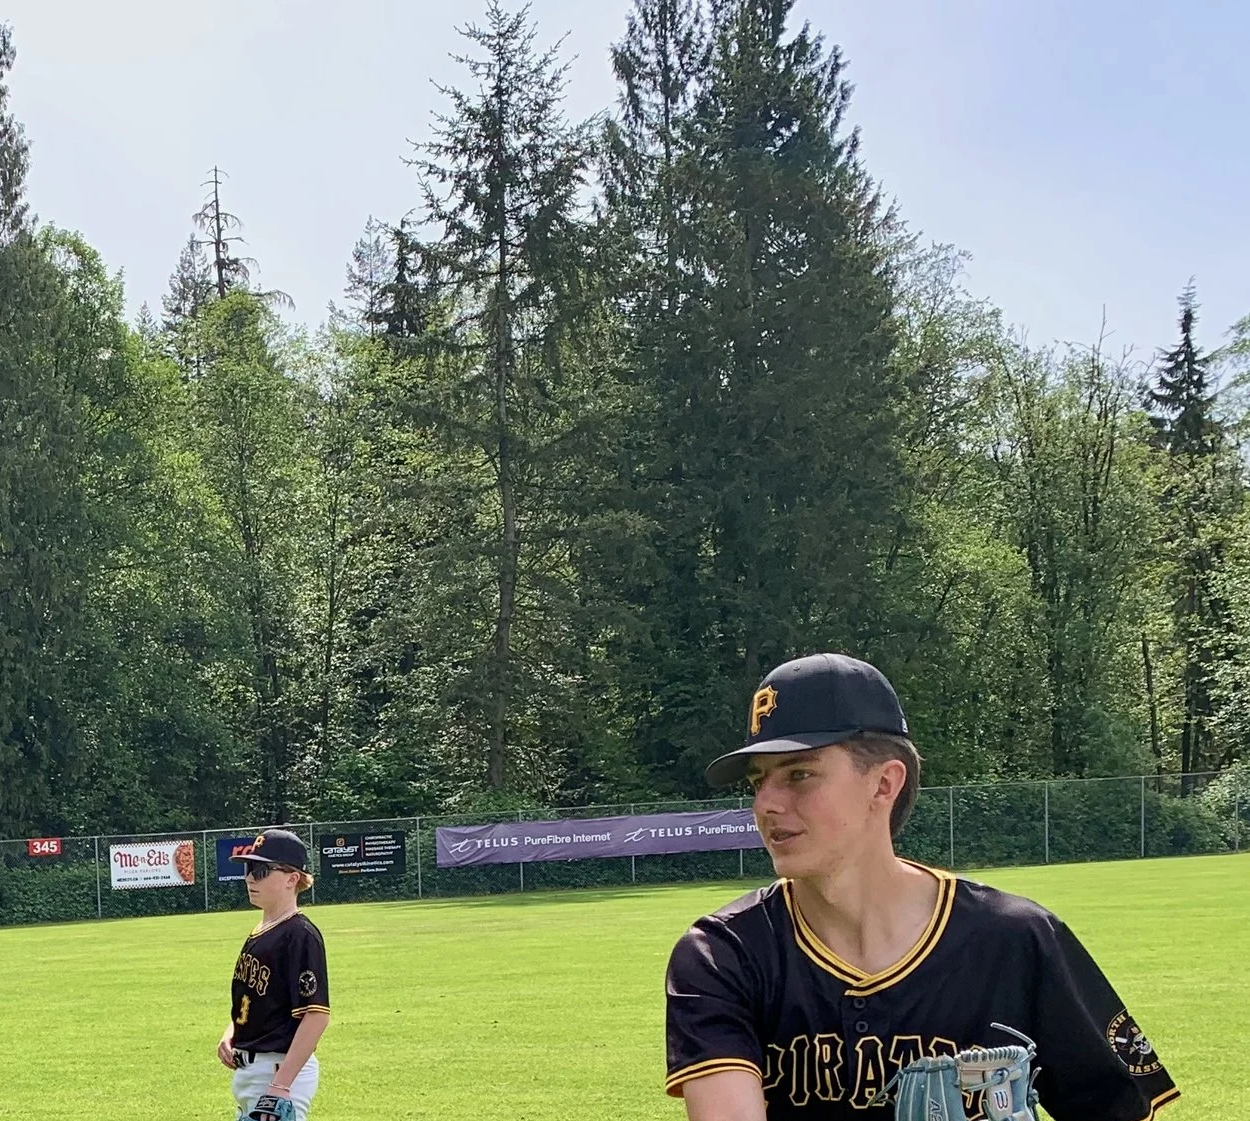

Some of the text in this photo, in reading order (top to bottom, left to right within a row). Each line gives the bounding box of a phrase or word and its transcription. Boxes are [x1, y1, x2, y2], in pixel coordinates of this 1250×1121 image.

[750, 684, 778, 736] P
[650, 827, 692, 837] TELUS
[698, 824, 744, 835] PureFibre
[476, 832, 611, 848] TELUS PureFibre Internet
[32, 841, 58, 854] 345
